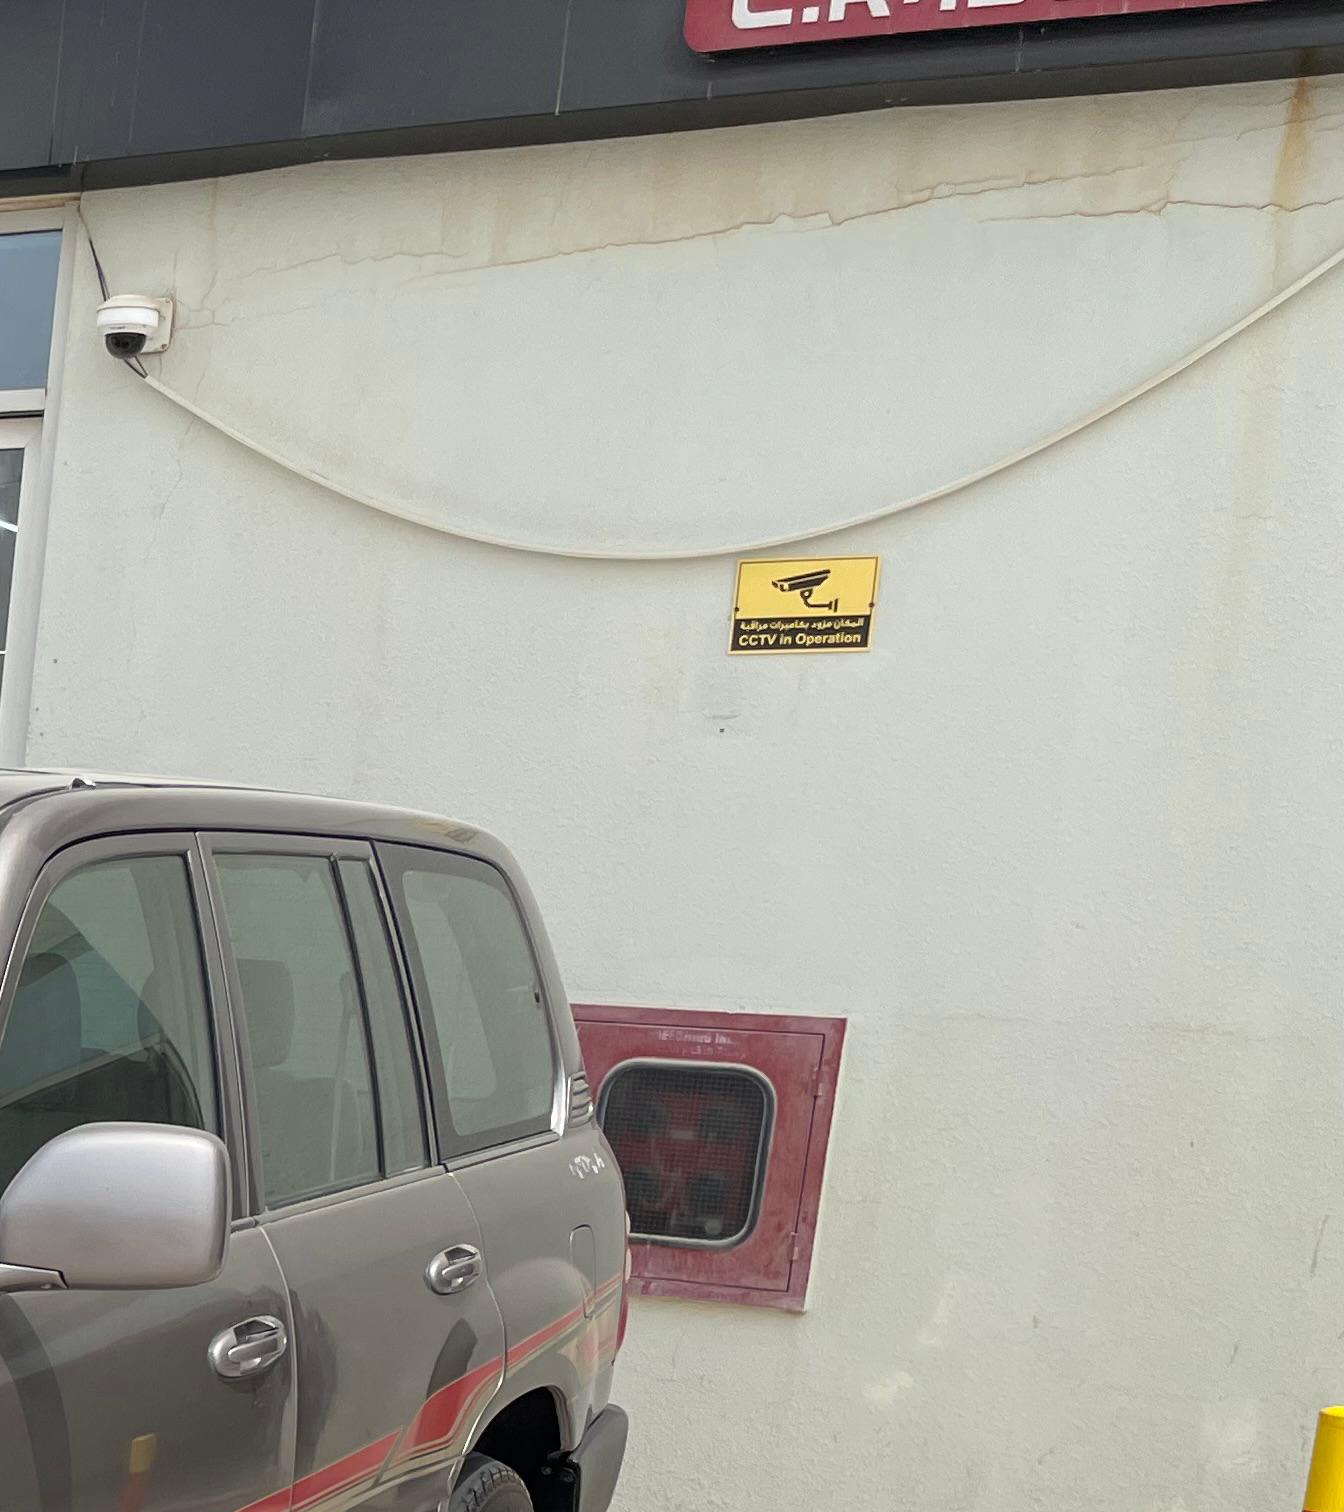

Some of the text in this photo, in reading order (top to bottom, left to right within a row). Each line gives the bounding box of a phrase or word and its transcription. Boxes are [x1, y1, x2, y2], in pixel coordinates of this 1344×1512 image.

[739, 632, 861, 646] CCTV in Operation
